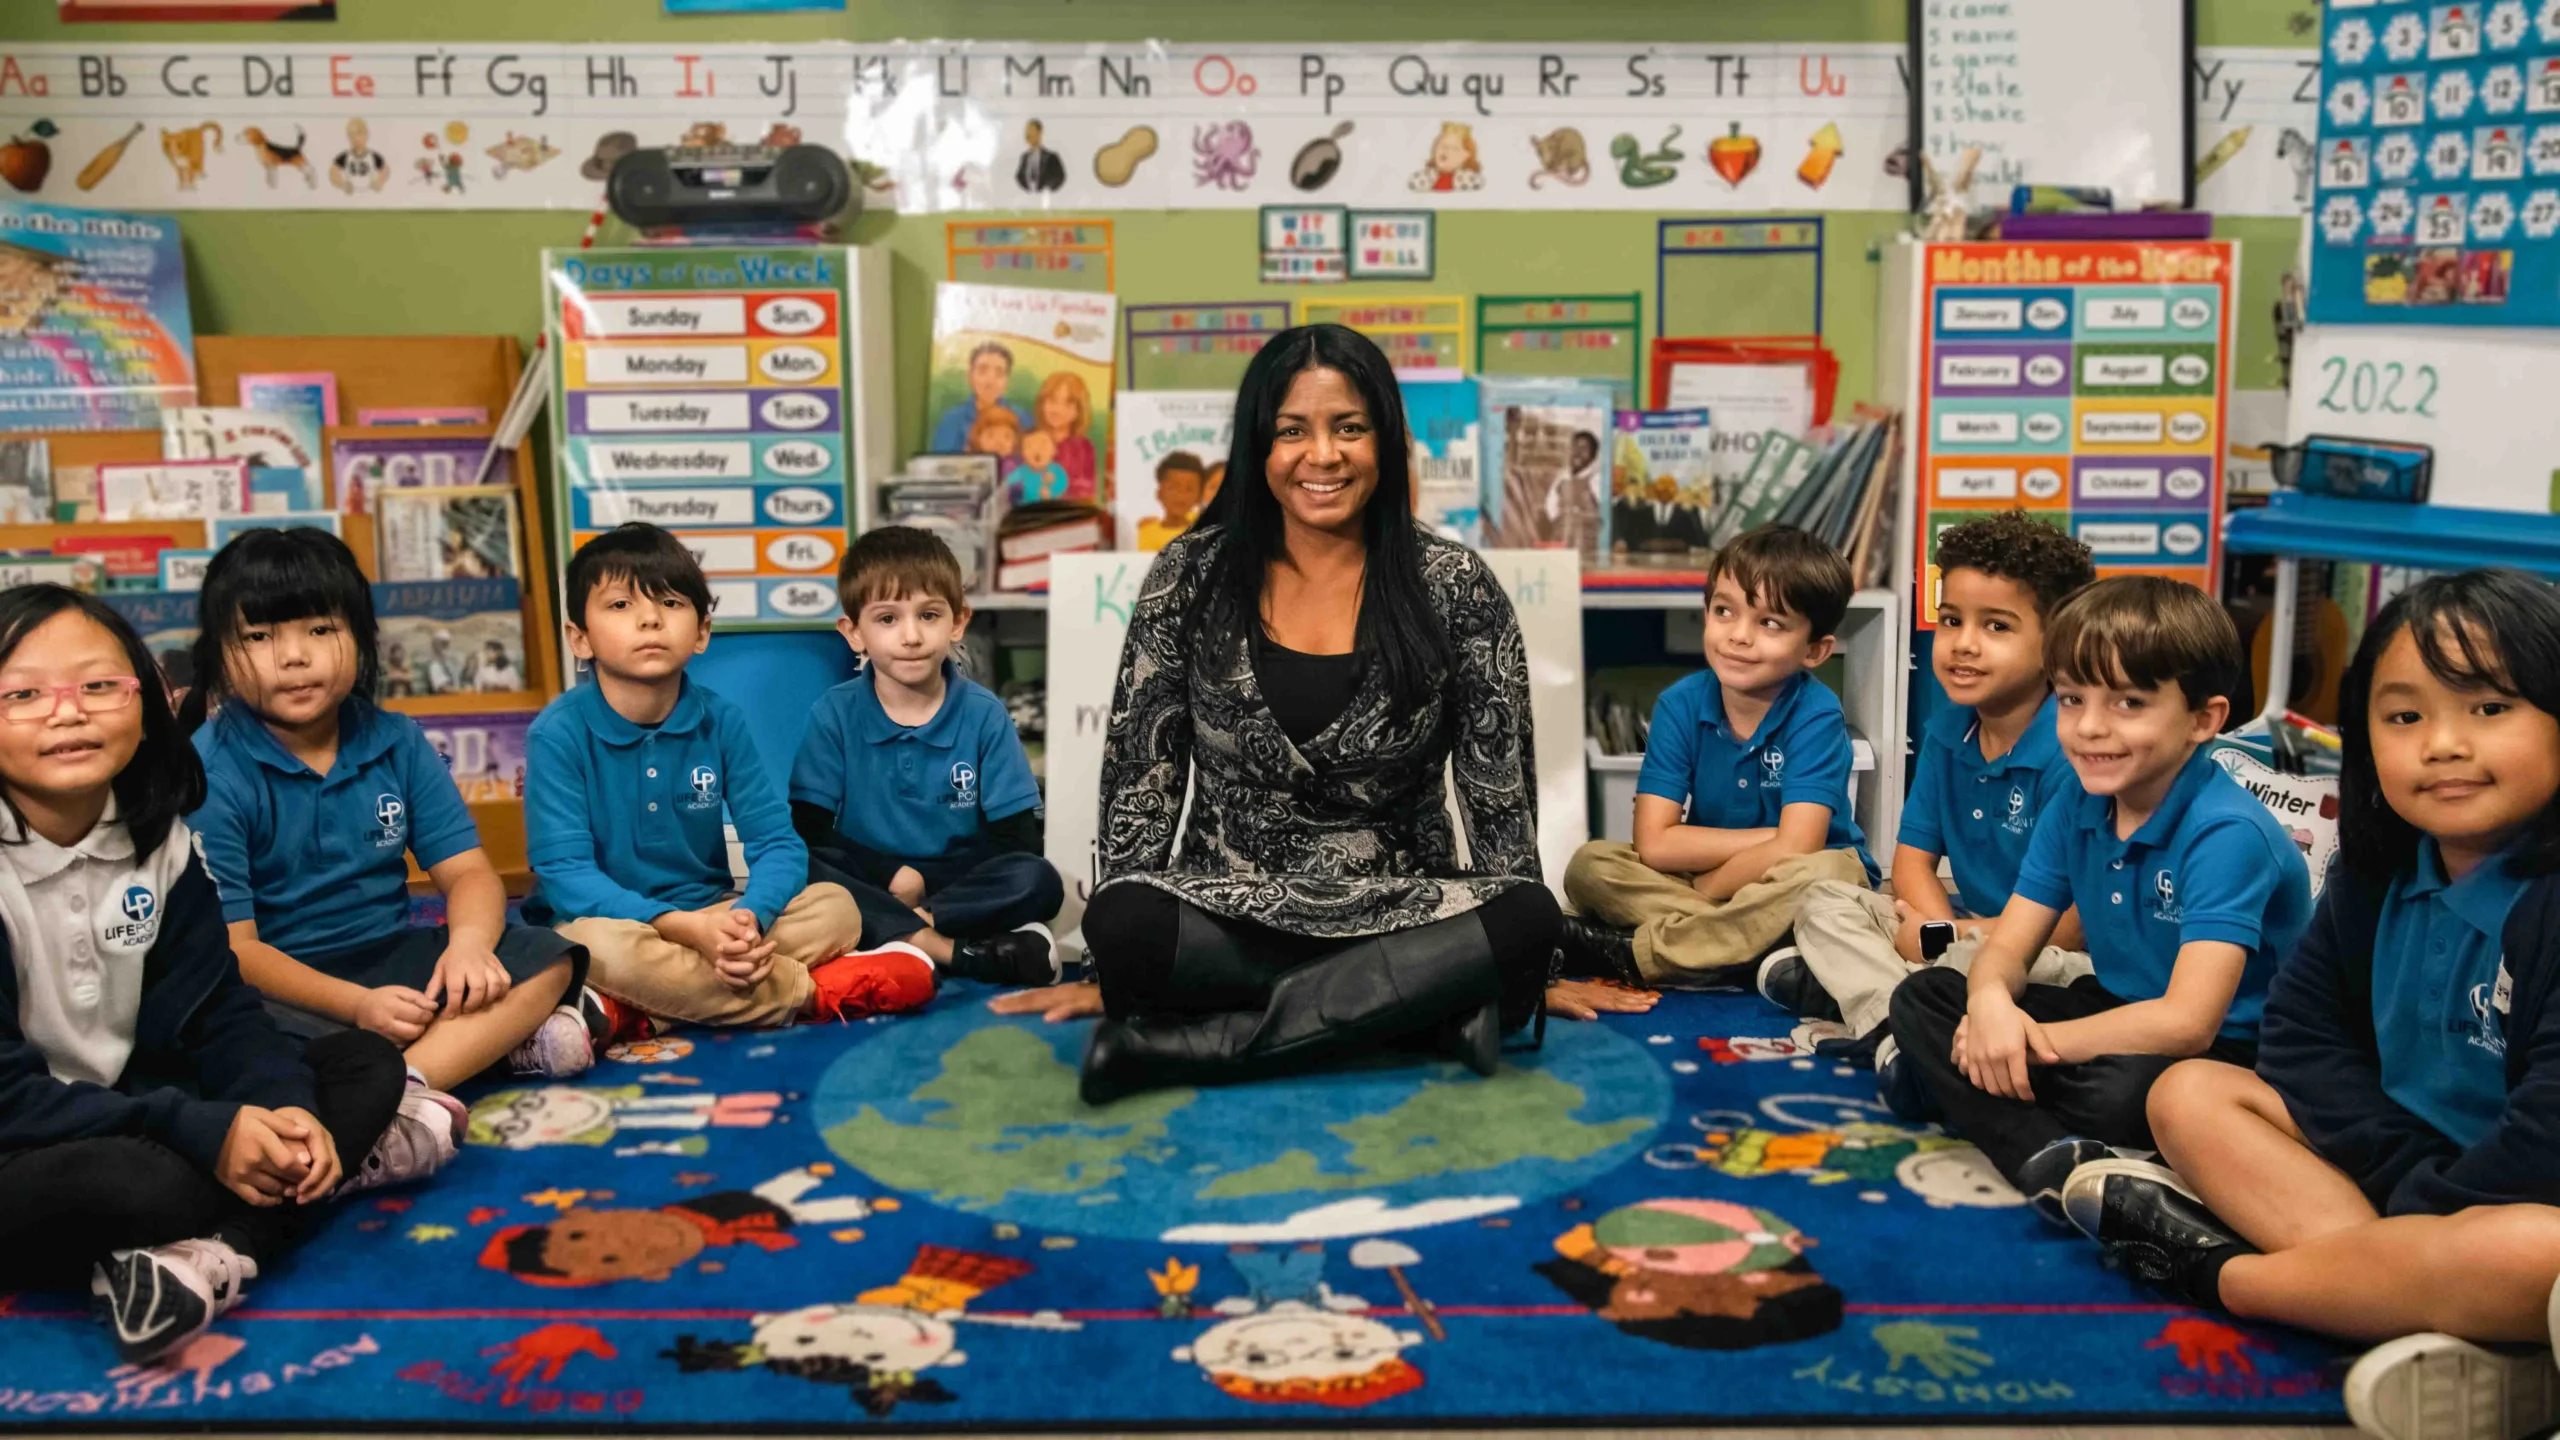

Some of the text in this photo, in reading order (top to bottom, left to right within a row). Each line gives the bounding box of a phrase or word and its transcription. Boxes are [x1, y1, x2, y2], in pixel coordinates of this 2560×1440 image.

[2501, 13, 2513, 34] 5
[1950, 29, 2018, 45] name
[2347, 32, 2357, 51] 2
[2399, 27, 2411, 47] 3
[0, 56, 49, 97] Aa
[80, 56, 126, 97] Bb
[162, 55, 209, 97] Cc
[243, 55, 294, 97] Dd
[330, 56, 375, 97] Ee
[416, 55, 457, 97] Ff
[586, 56, 637, 97] Hh
[674, 56, 715, 97] Ii
[938, 56, 969, 97] Ll
[1005, 56, 1075, 97] Mm
[1100, 56, 1151, 97] Nn
[1194, 55, 1256, 96] Oo
[1540, 55, 1579, 96] Rr
[1627, 55, 1665, 96] Ss
[1706, 55, 1750, 96] Tt
[1800, 55, 1846, 96] Uu
[1951, 53, 2018, 79] game
[486, 55, 548, 116] Gg
[759, 56, 796, 116] Jj
[1301, 55, 1344, 115] Pp
[1389, 55, 1504, 116] Qu qu
[2193, 60, 2244, 121] Yy
[2445, 85, 2460, 103] 11
[2493, 79, 2511, 98] 12
[1950, 97, 2027, 124] shake
[2342, 93, 2354, 111] 9
[2388, 99, 2408, 119] 10
[2387, 146, 2406, 164] 17
[2439, 146, 2458, 165] 18
[2487, 152, 2507, 172] 19
[2335, 162, 2353, 182] 16
[1281, 214, 1325, 231] WIT
[2331, 208, 2352, 228] 23
[2380, 203, 2402, 222] 24
[2480, 206, 2503, 226] 26
[2532, 203, 2555, 223] 27
[83, 217, 163, 240] Bible
[1360, 223, 1420, 239] FOCUS
[2430, 215, 2450, 239] 25
[1365, 249, 1418, 265] WALL
[1932, 248, 2223, 282] Months of the Year
[564, 256, 834, 288] Days of the Week
[628, 308, 702, 329] Sunday
[772, 307, 813, 324] Sun.
[1954, 306, 2009, 323] January
[2110, 305, 2139, 323] July
[2177, 305, 2205, 322] July
[626, 355, 707, 376] Monday
[772, 354, 819, 371] Mon.
[1949, 364, 2010, 380] February
[2099, 363, 2149, 380] August
[2317, 355, 2441, 418] 2022
[628, 402, 711, 423] Tuesday
[773, 401, 822, 418] Tues.
[1152, 421, 1217, 453] Believe
[1957, 420, 2001, 434] March
[2084, 420, 2158, 437] September
[611, 450, 729, 471] Wednesday
[772, 450, 820, 467] Wed.
[1421, 456, 1474, 480] DREAM
[1960, 475, 1994, 492] April
[2091, 475, 2150, 491] October
[628, 498, 719, 519] Thursday
[772, 497, 826, 515] Thurs.
[2083, 531, 2152, 546] November
[786, 543, 818, 561] Fri.
[786, 589, 824, 606] Sat.
[1763, 749, 1783, 772] LP
[692, 768, 716, 793] LP
[951, 765, 974, 791] LP
[2244, 779, 2316, 817] Winter
[378, 797, 402, 826] LP
[123, 892, 152, 920] LP
[1792, 1356, 2076, 1404] HONESTY
